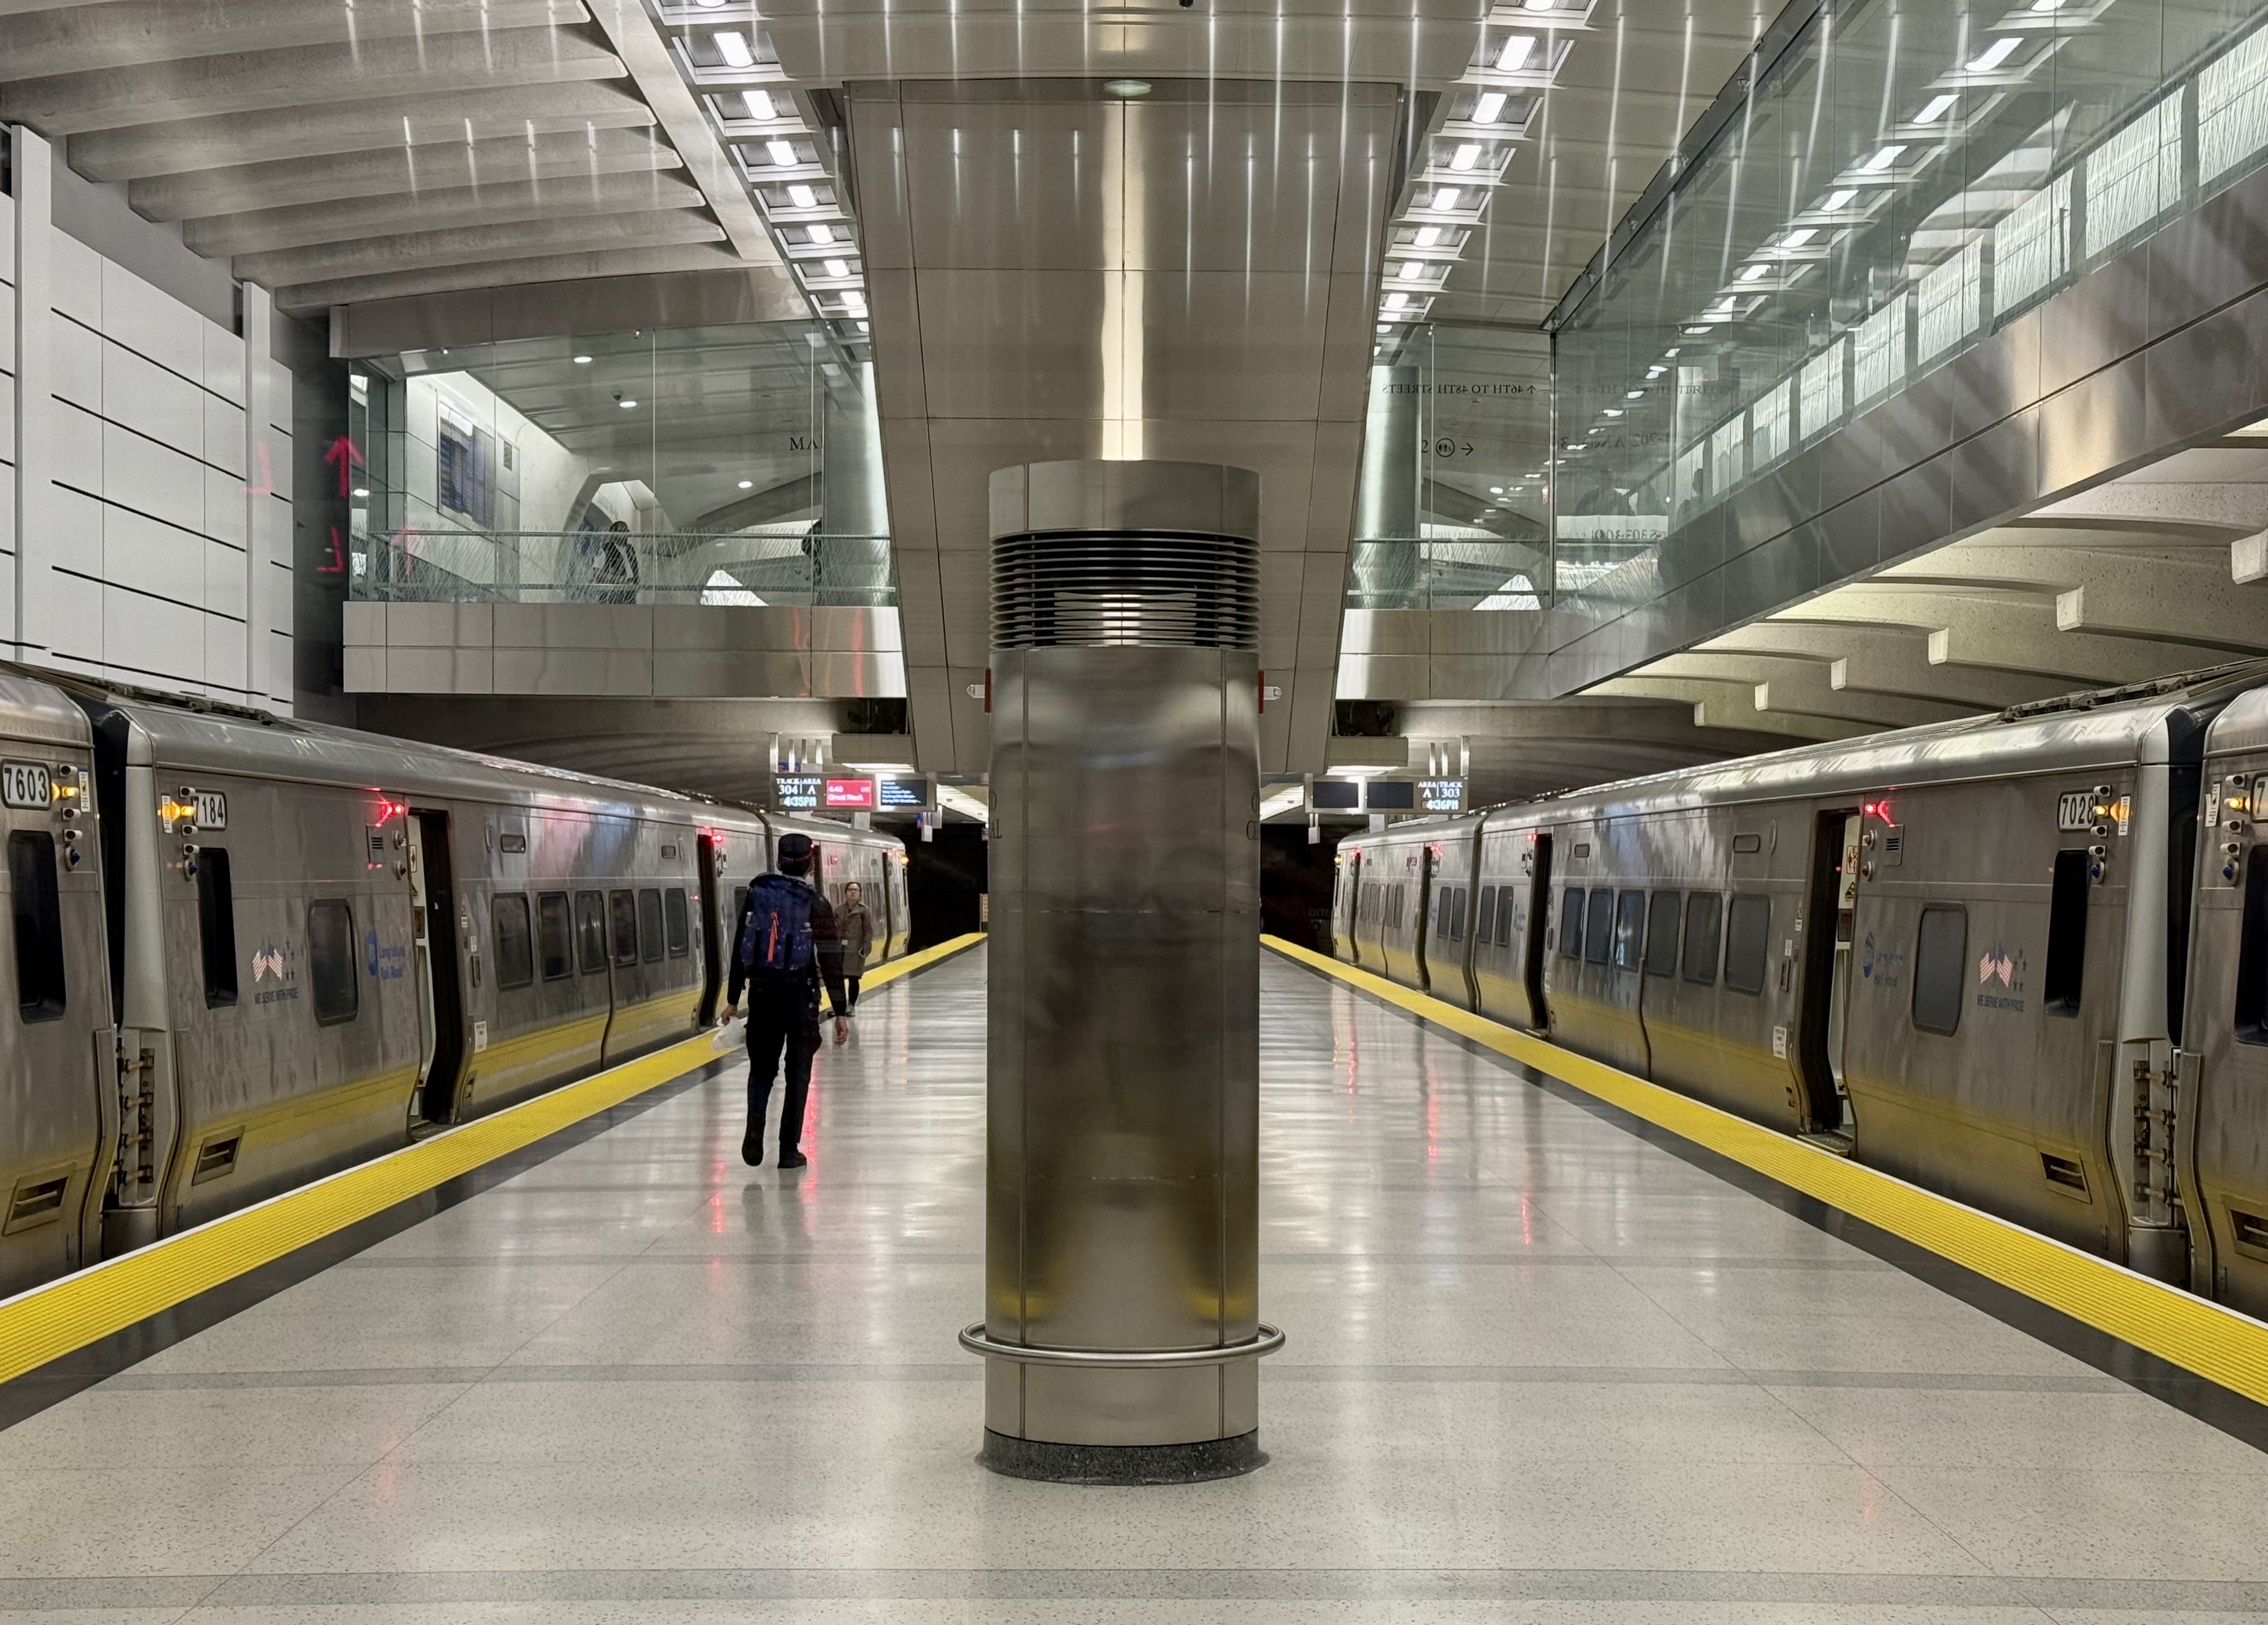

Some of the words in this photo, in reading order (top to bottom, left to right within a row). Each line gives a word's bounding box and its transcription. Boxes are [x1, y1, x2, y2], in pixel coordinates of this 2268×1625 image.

[790, 436, 823, 451] MA
[4, 768, 47, 802] 7603
[778, 784, 798, 795] 304
[807, 784, 816, 795] A
[1423, 788, 1432, 798] A
[1441, 788, 1460, 798] 303
[193, 795, 224, 824] 7184
[2061, 795, 2094, 825] 7028
[255, 993, 261, 1004] WE
[262, 990, 276, 1004] SERVE
[1977, 994, 1983, 1006] WE
[1984, 995, 1998, 1008] SERVE
